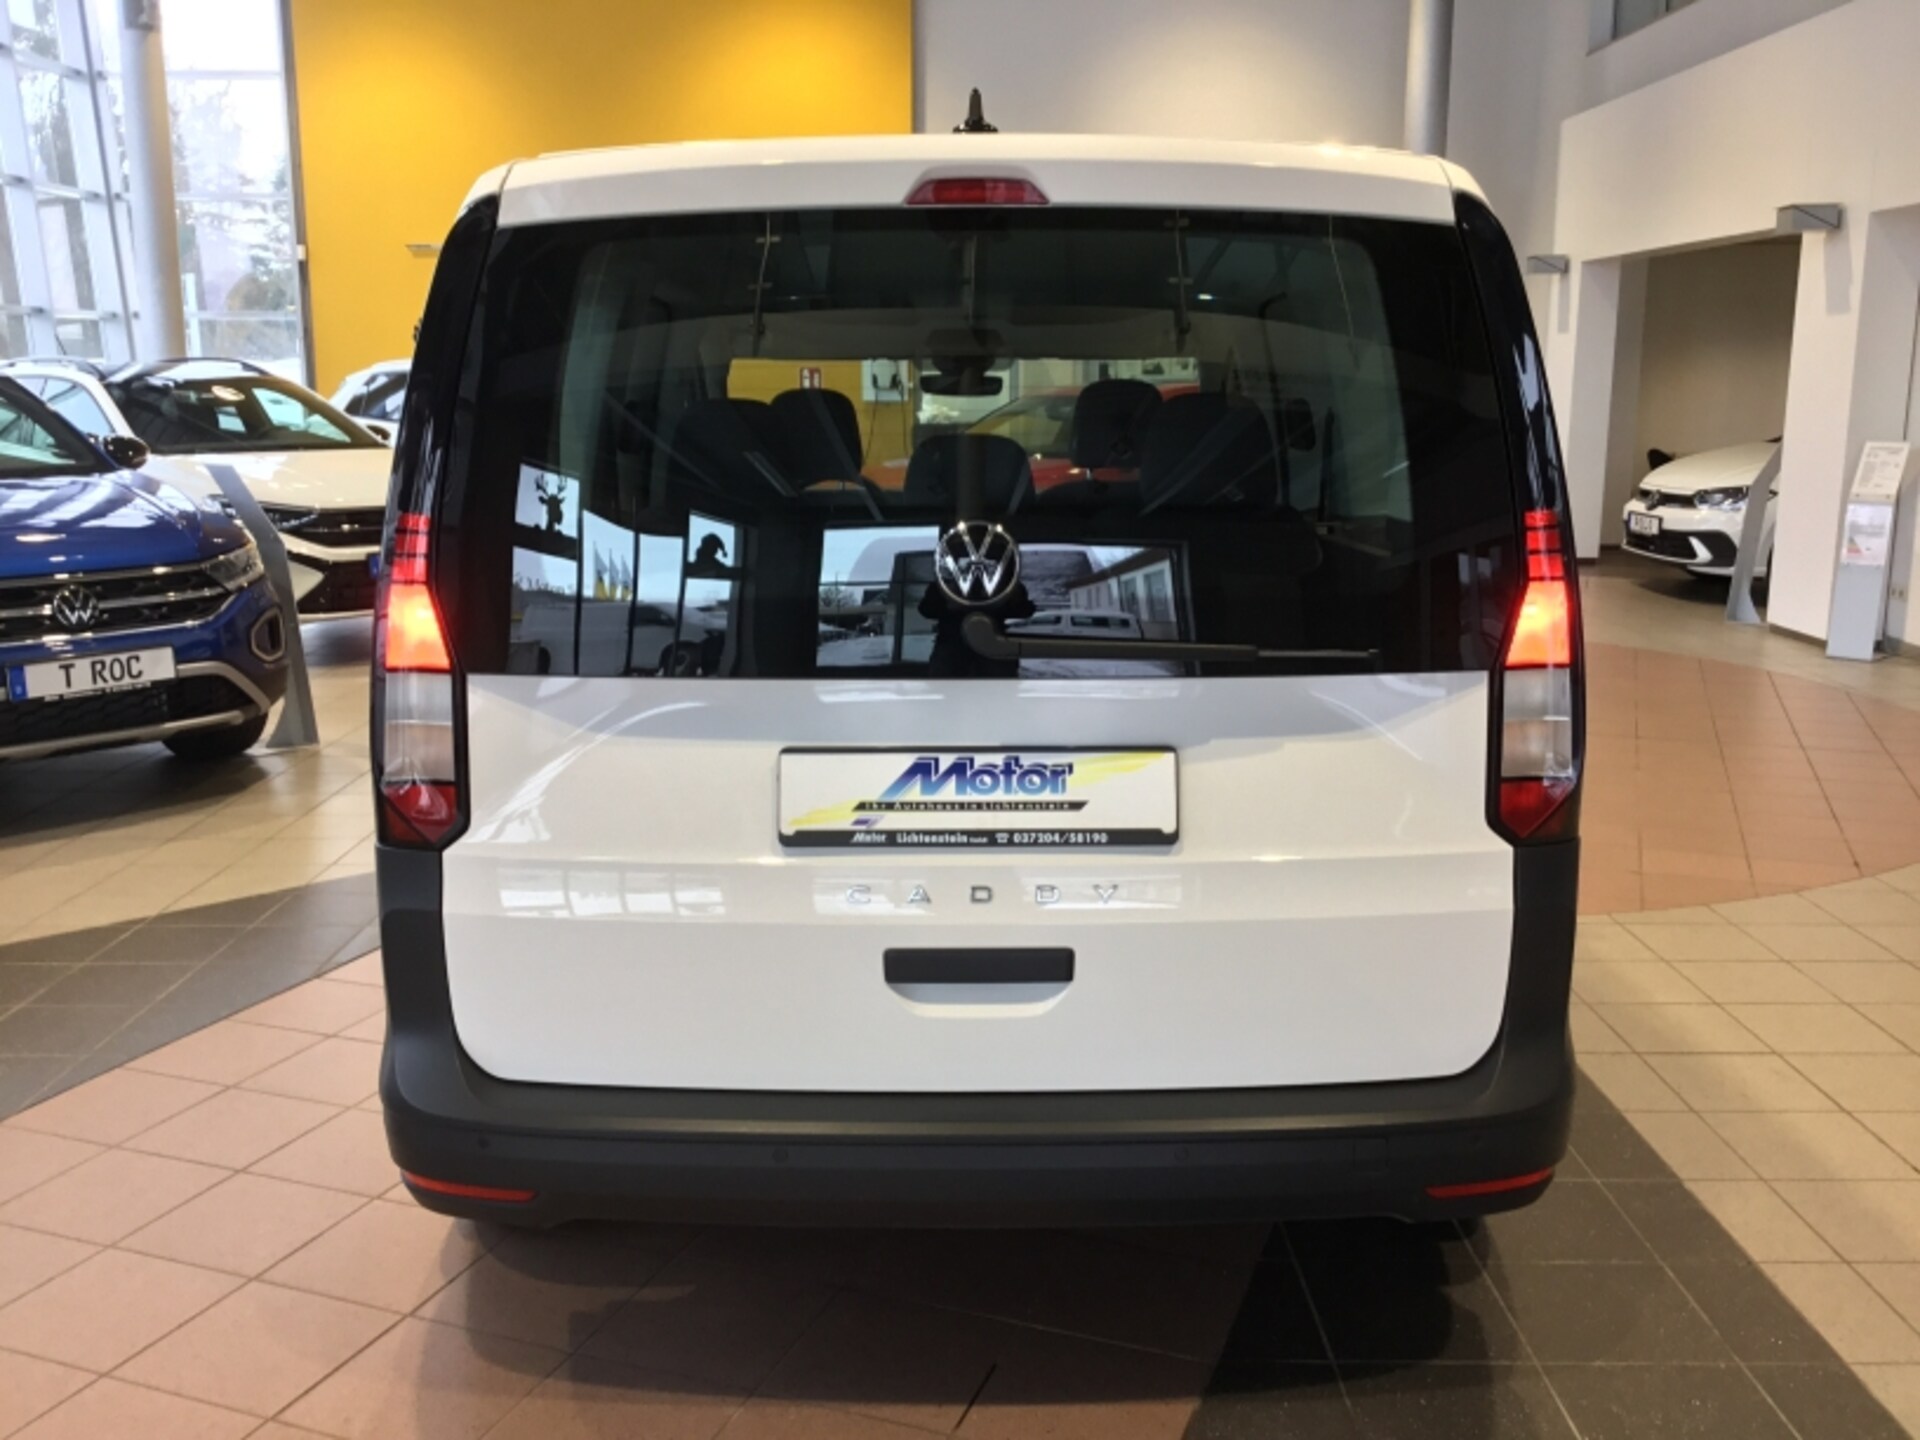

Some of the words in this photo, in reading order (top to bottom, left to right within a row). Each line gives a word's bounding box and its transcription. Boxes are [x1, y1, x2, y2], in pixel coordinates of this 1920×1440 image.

[58, 663, 75, 688] T
[90, 654, 143, 686] ROC
[877, 755, 1074, 801] Motor
[864, 801, 887, 811] Ihr
[893, 801, 961, 811] Autohaus
[964, 801, 978, 811] in
[982, 801, 1070, 811] Lichtenstein
[850, 832, 888, 844] Motor
[896, 831, 968, 844] Lichtenstein
[1013, 832, 1109, 843] 037204/58190
[846, 885, 1118, 904] CADDY
